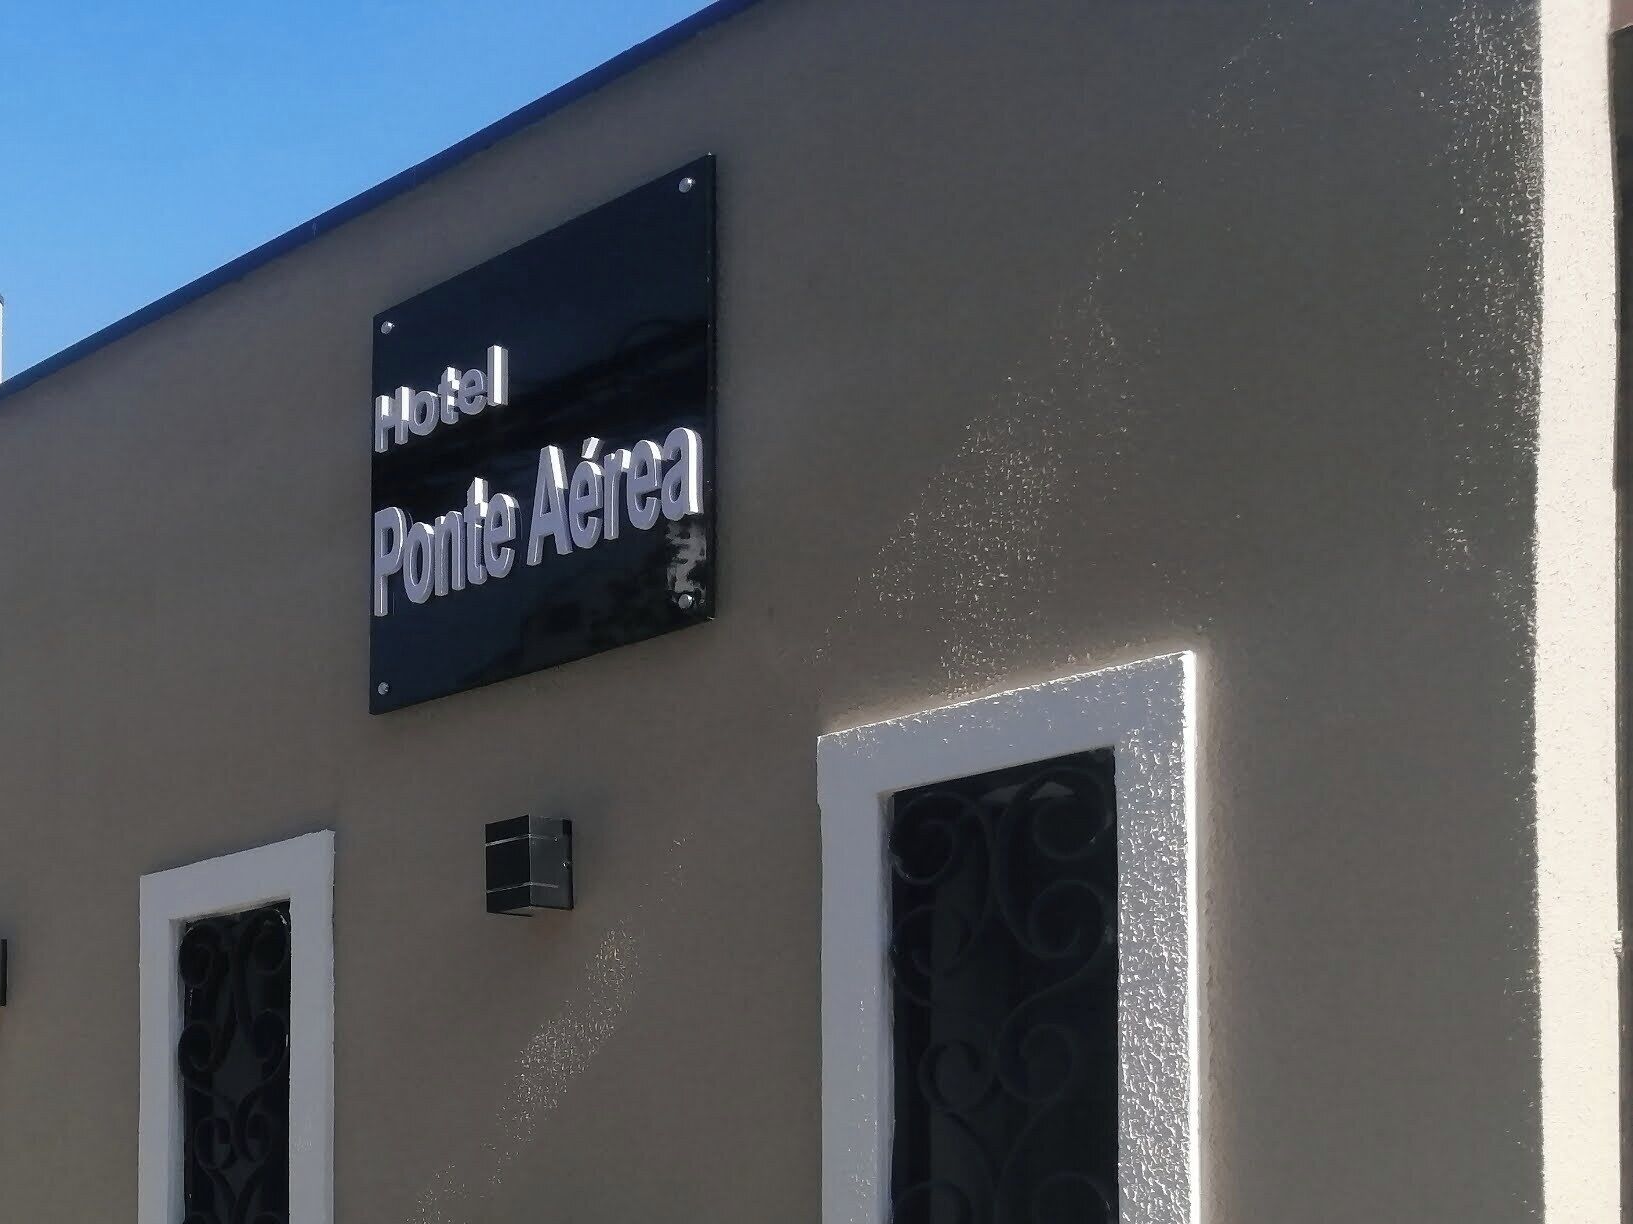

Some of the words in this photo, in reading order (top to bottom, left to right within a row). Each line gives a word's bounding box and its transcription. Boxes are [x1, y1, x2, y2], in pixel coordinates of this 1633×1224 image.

[374, 344, 509, 453] Hotel
[373, 477, 519, 617] Ponte
[526, 426, 705, 567] Aérea
